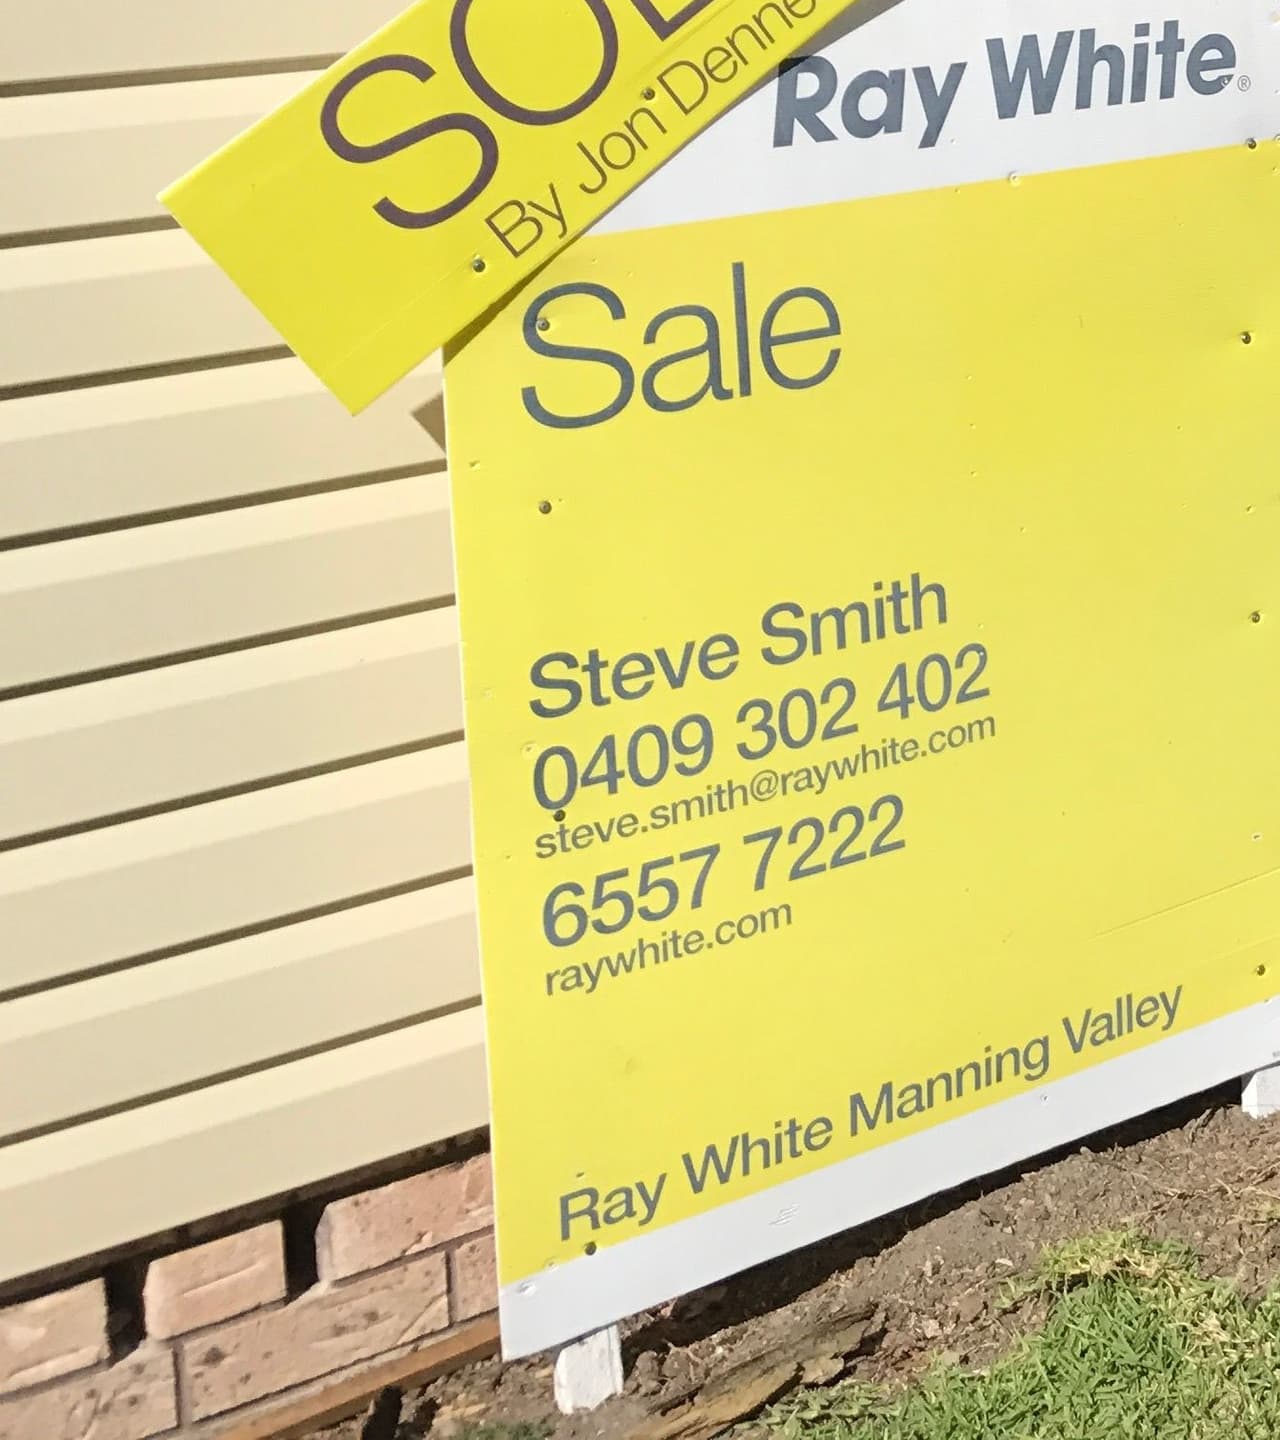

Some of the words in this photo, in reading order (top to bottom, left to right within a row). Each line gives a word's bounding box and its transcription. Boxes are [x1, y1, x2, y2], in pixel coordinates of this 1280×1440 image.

[773, 54, 968, 149] Ray
[985, 18, 1237, 120] White
[484, 182, 568, 258] By
[577, 107, 668, 195] Jon
[521, 261, 842, 430] Sale
[529, 632, 740, 719] Steve
[760, 572, 948, 665] Smith
[532, 713, 714, 811] 0409
[736, 677, 859, 760] 302
[877, 642, 991, 720] 402
[534, 715, 997, 860] steve.smith@raywhite.com
[542, 843, 721, 948] 6557
[743, 793, 906, 892] 7222
[545, 902, 793, 996] raywhite.com
[559, 1172, 668, 1241] Ray
[681, 1107, 834, 1195] White
[849, 1034, 1051, 1137] Manning
[1062, 984, 1184, 1055] Valley
